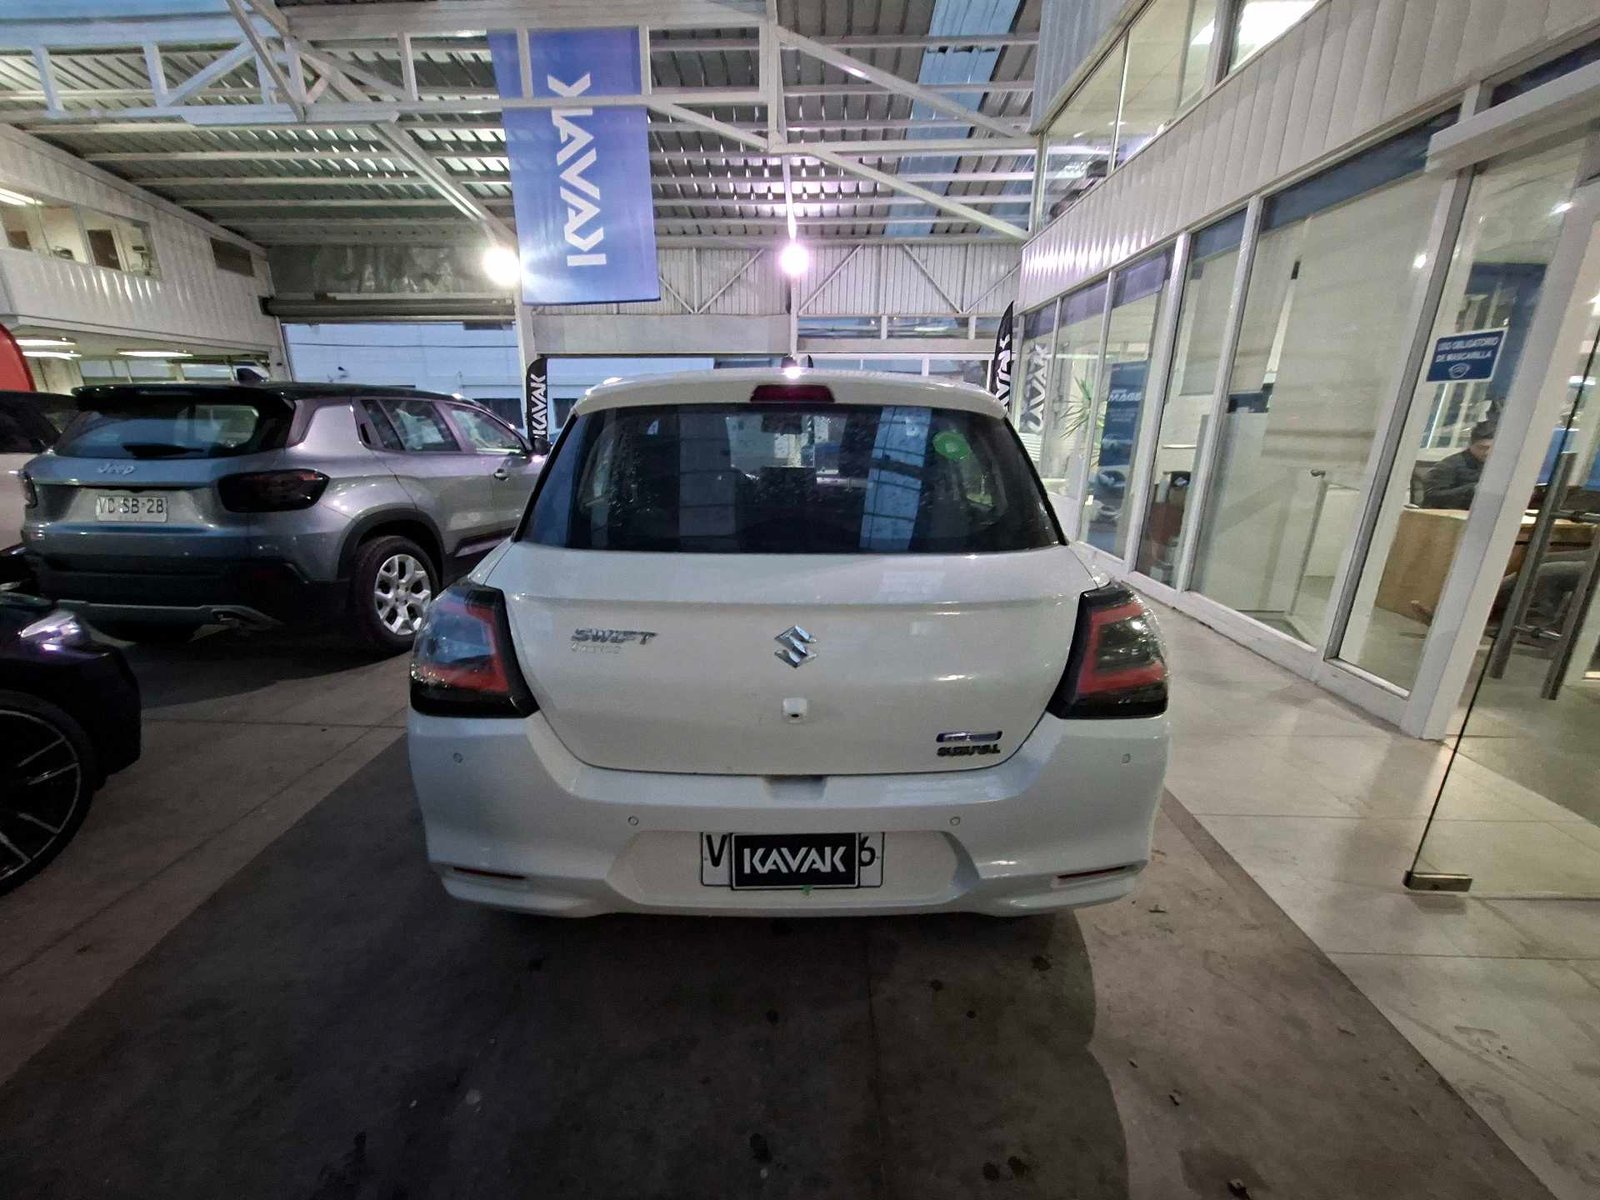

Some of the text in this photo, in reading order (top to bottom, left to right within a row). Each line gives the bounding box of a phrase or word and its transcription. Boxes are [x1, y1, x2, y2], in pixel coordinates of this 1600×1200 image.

[547, 72, 607, 267] KAVAK
[530, 373, 547, 435] KAVAK
[570, 628, 658, 645] SWIFT
[743, 846, 847, 874] KAVAK
